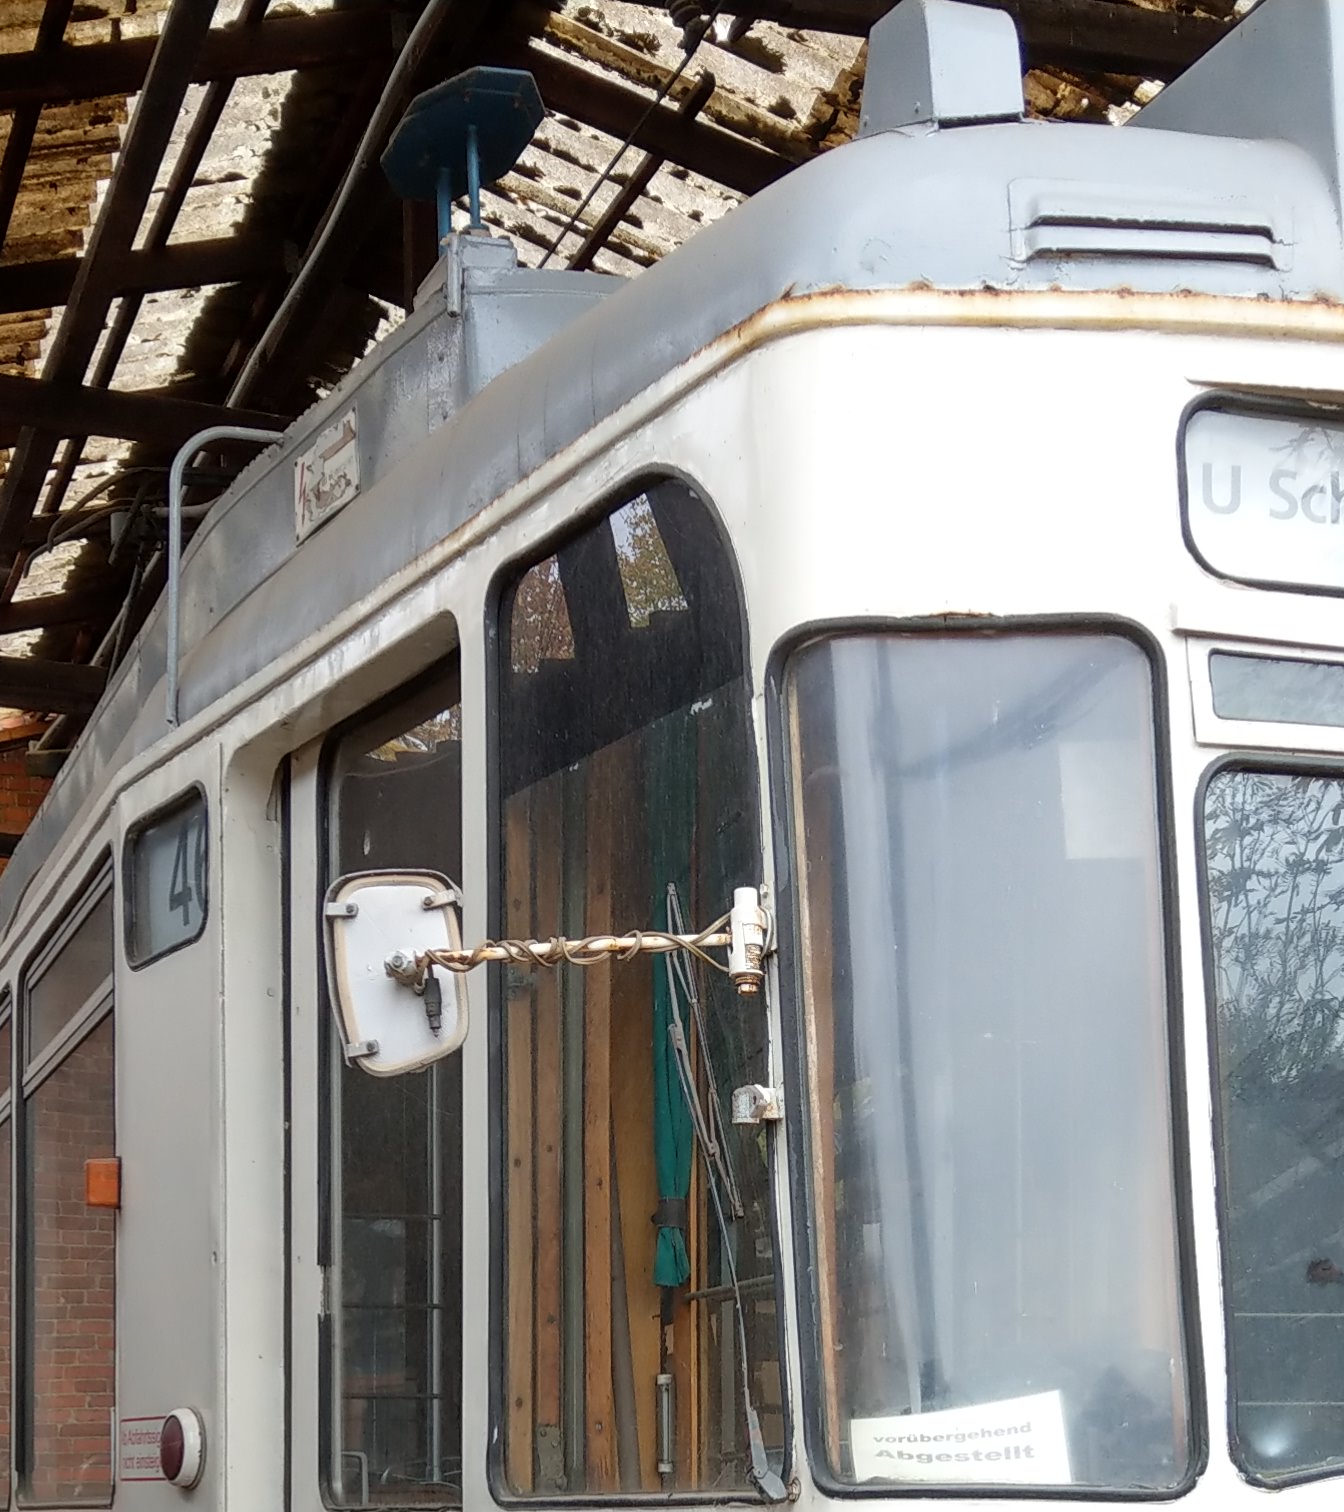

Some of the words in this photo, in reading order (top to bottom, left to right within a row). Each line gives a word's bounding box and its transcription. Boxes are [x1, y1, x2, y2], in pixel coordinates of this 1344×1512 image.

[1202, 462, 1242, 515] U
[872, 1421, 1032, 1444] vorübergehend
[874, 1444, 1036, 1464] Abgestellt
